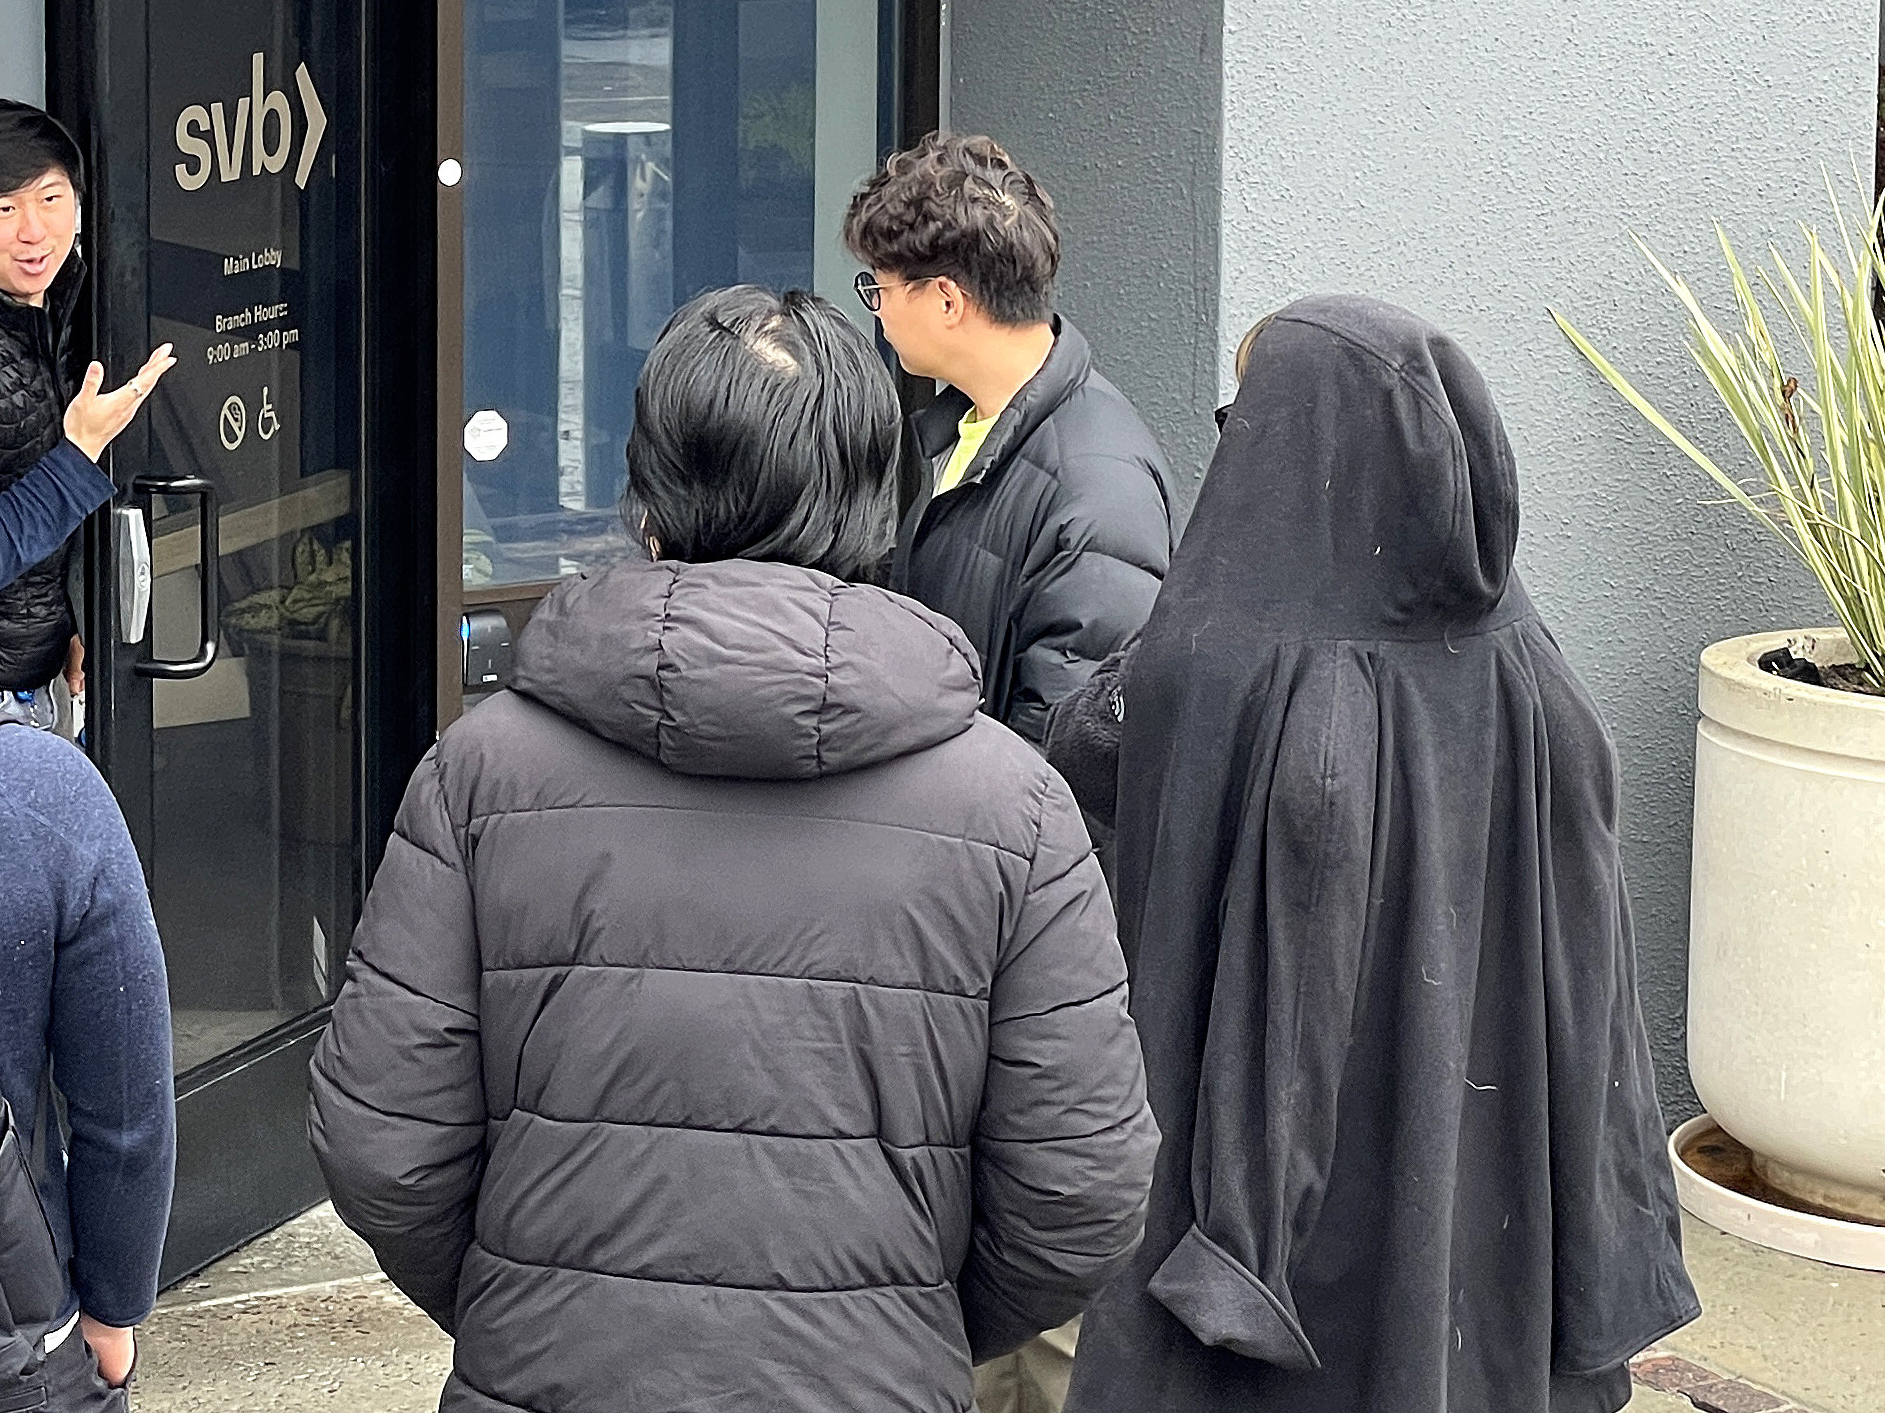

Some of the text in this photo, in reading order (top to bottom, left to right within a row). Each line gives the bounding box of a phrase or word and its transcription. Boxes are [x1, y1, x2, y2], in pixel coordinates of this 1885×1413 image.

[174, 51, 292, 191] svb
[223, 247, 283, 276] Main Lobby
[215, 307, 252, 333] Branch
[206, 342, 231, 365] 9:00
[232, 341, 250, 358] am
[257, 328, 281, 352] 3:00
[282, 328, 299, 350] pm
